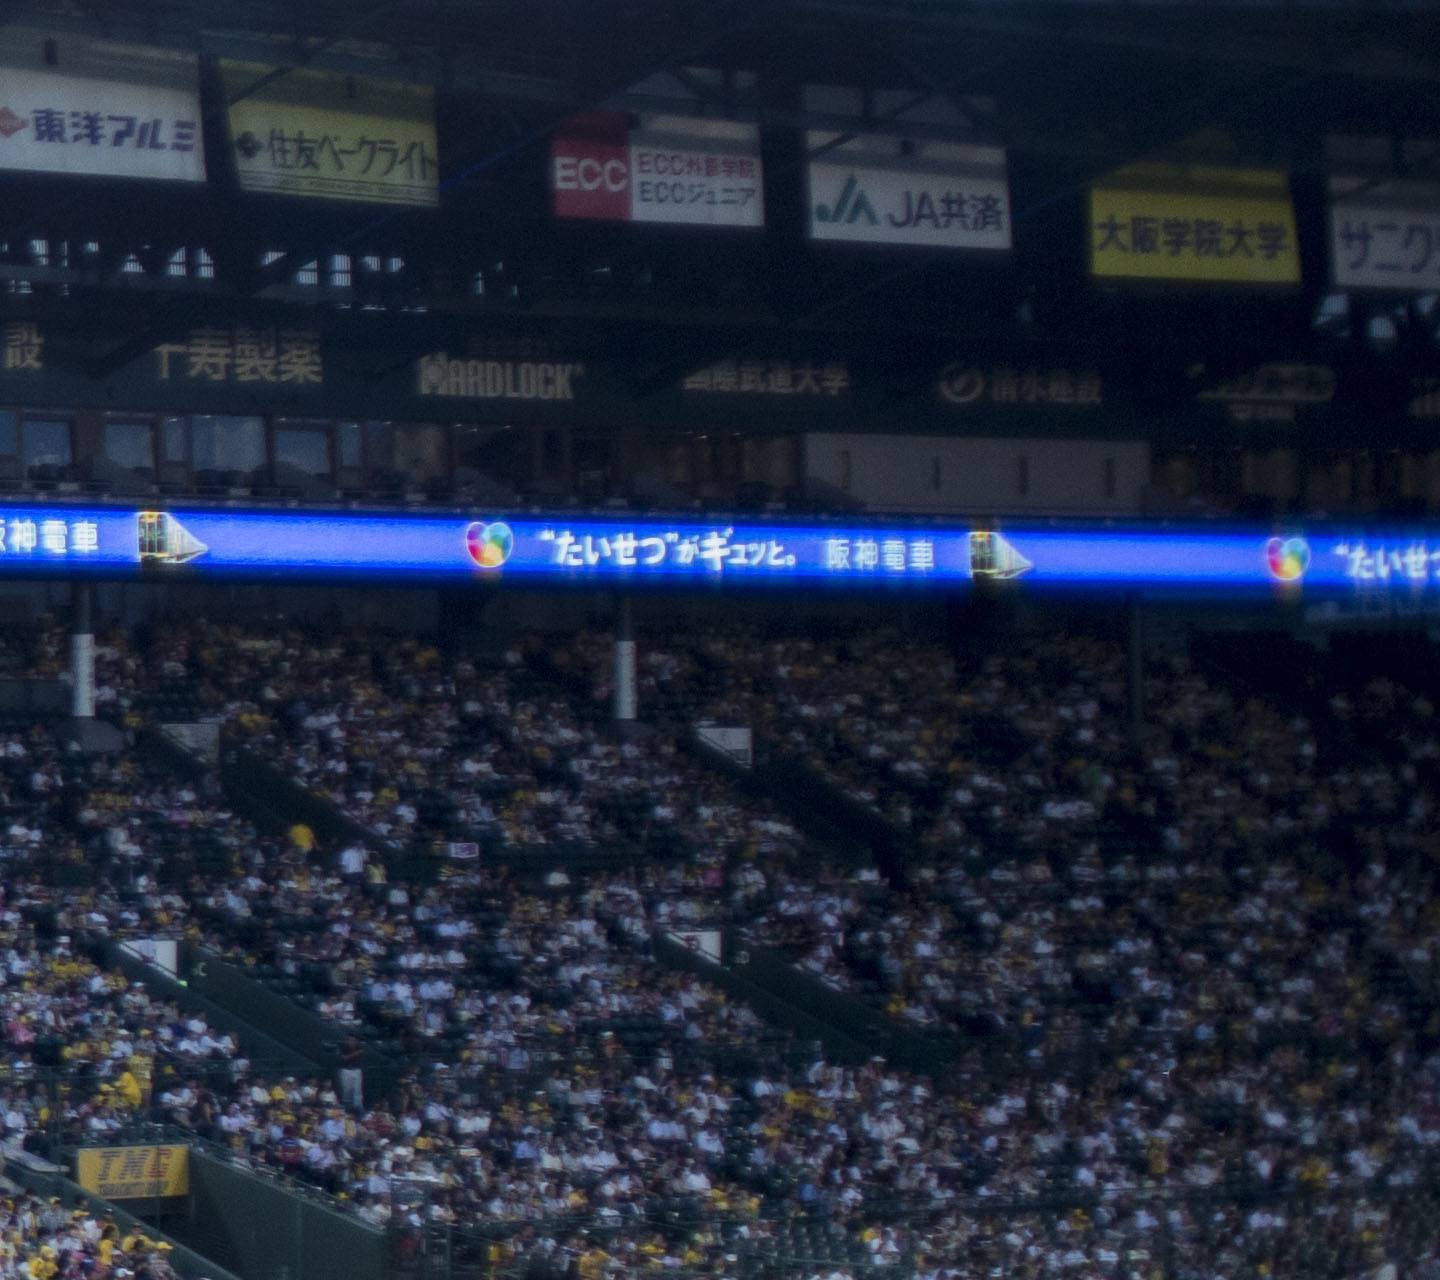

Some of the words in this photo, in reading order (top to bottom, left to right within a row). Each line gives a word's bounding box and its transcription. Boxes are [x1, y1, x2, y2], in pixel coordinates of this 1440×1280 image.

[31, 107, 196, 153] 東洋アルミ
[554, 155, 628, 193] ECC
[887, 190, 1003, 233] JA共済
[1096, 214, 1289, 261] 大阪学院大学
[1340, 219, 1440, 273] サニク
[826, 538, 935, 571] 阪神電車
